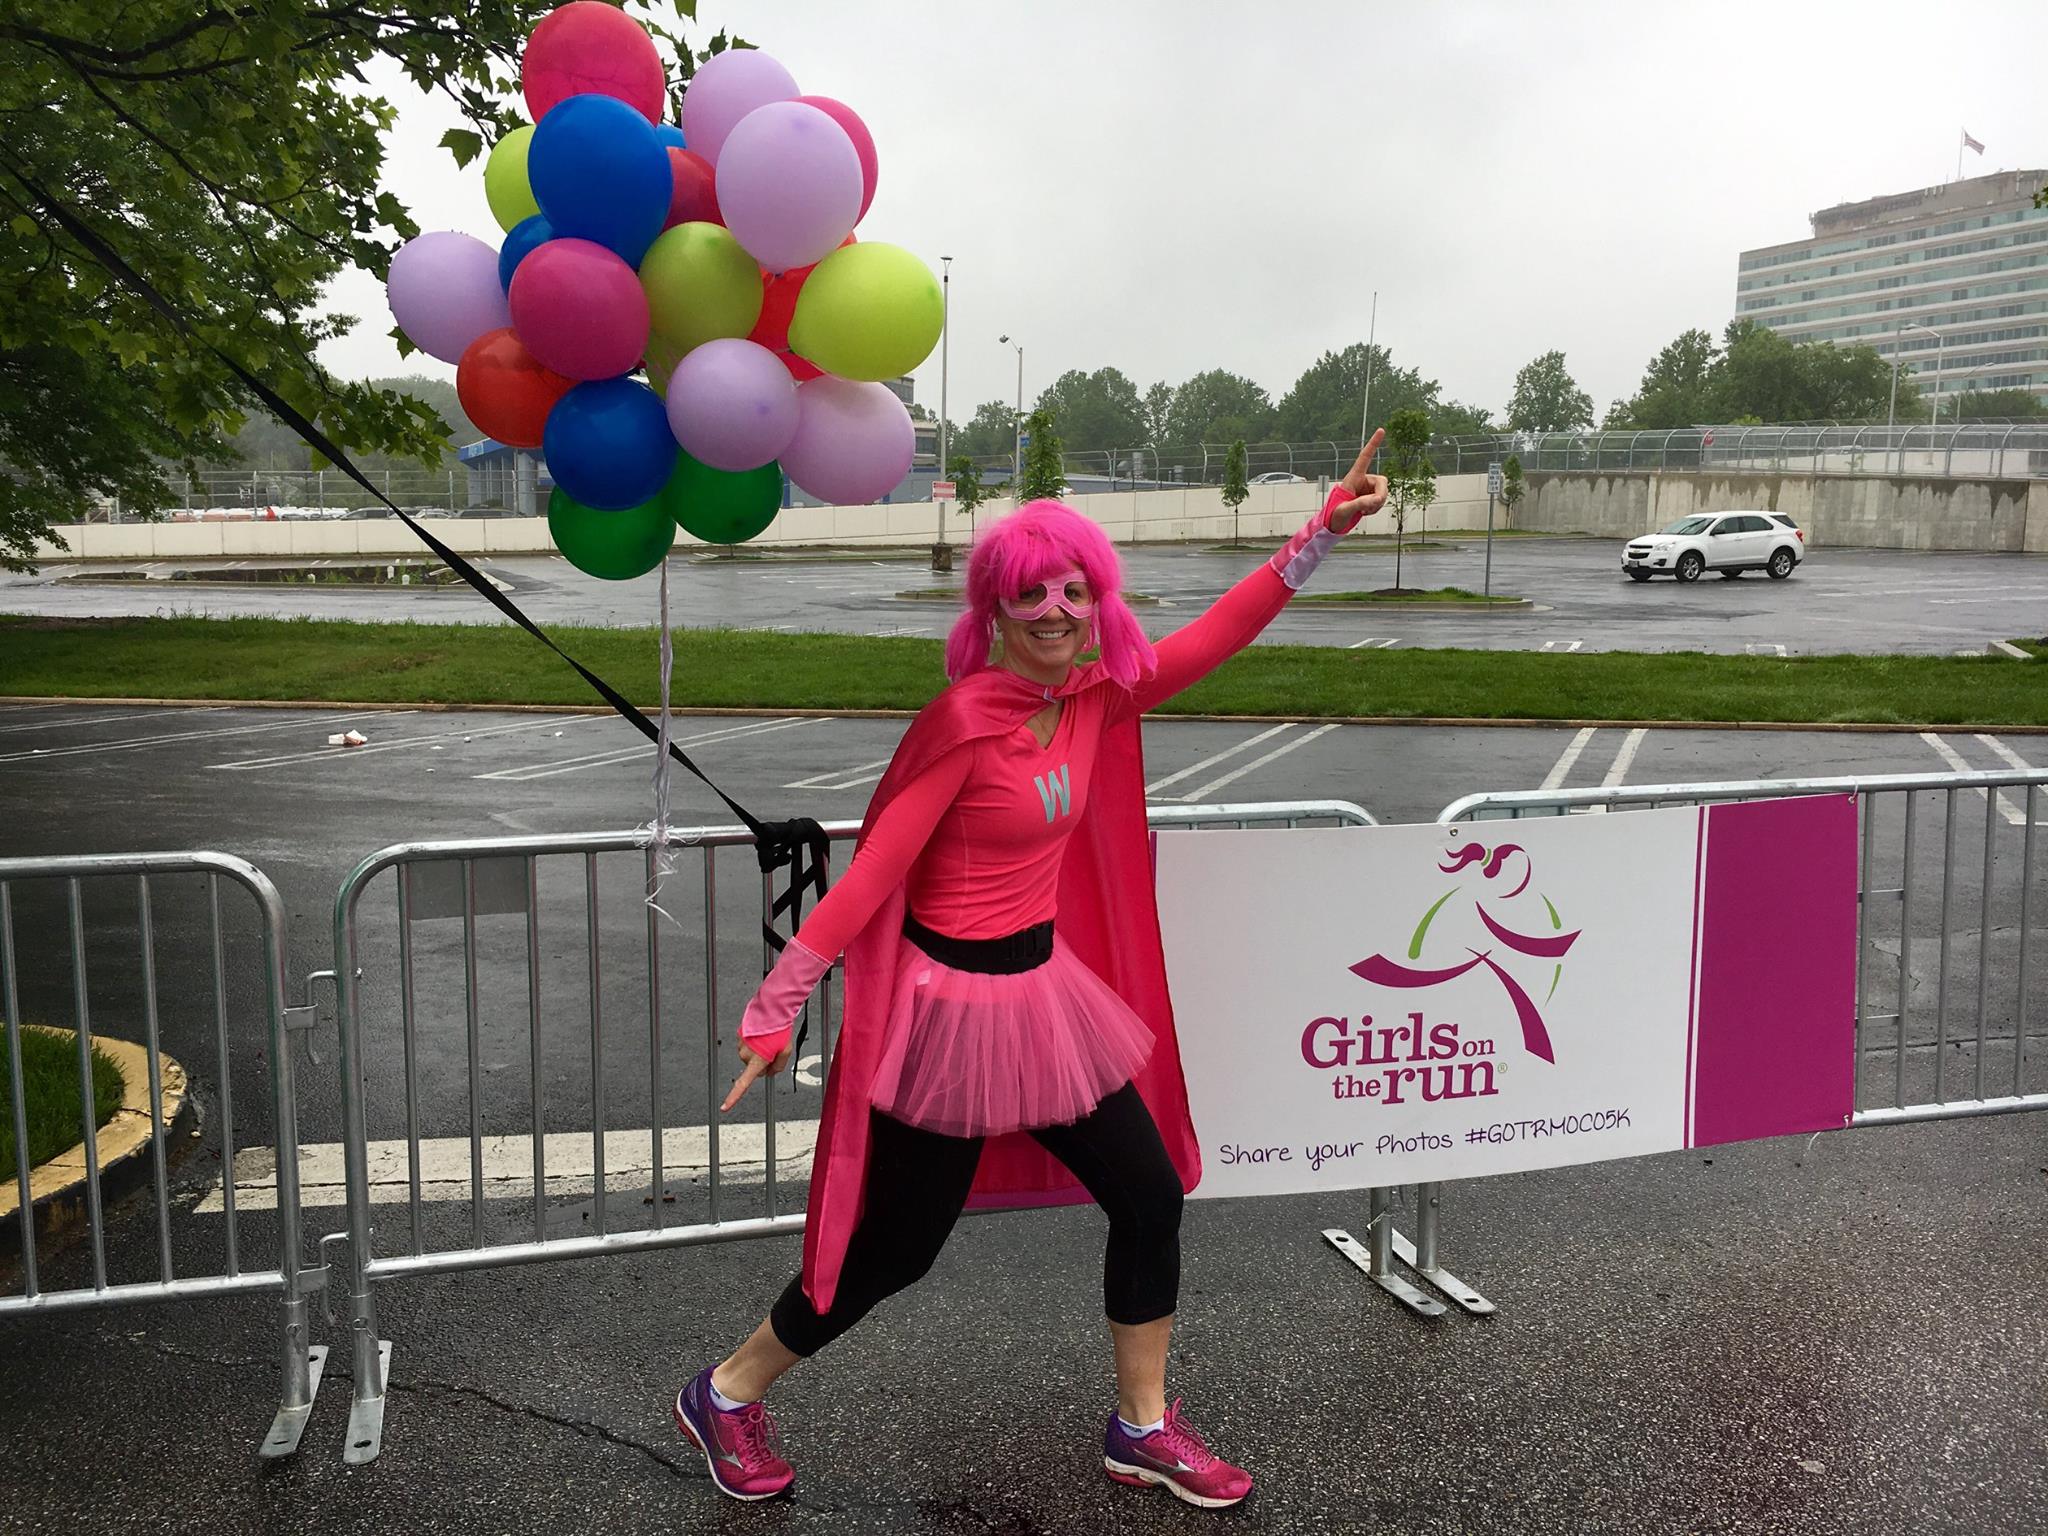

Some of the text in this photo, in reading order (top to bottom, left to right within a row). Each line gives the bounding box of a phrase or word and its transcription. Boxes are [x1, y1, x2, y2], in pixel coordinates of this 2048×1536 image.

[1033, 763, 1071, 824] W
[1301, 1010, 1496, 1069] Girls on
[1332, 1060, 1499, 1105] the run
[1219, 1143, 1293, 1165] Share
[1305, 1142, 1364, 1172] your
[1464, 1108, 1631, 1144] #GOTRMOCO5K
